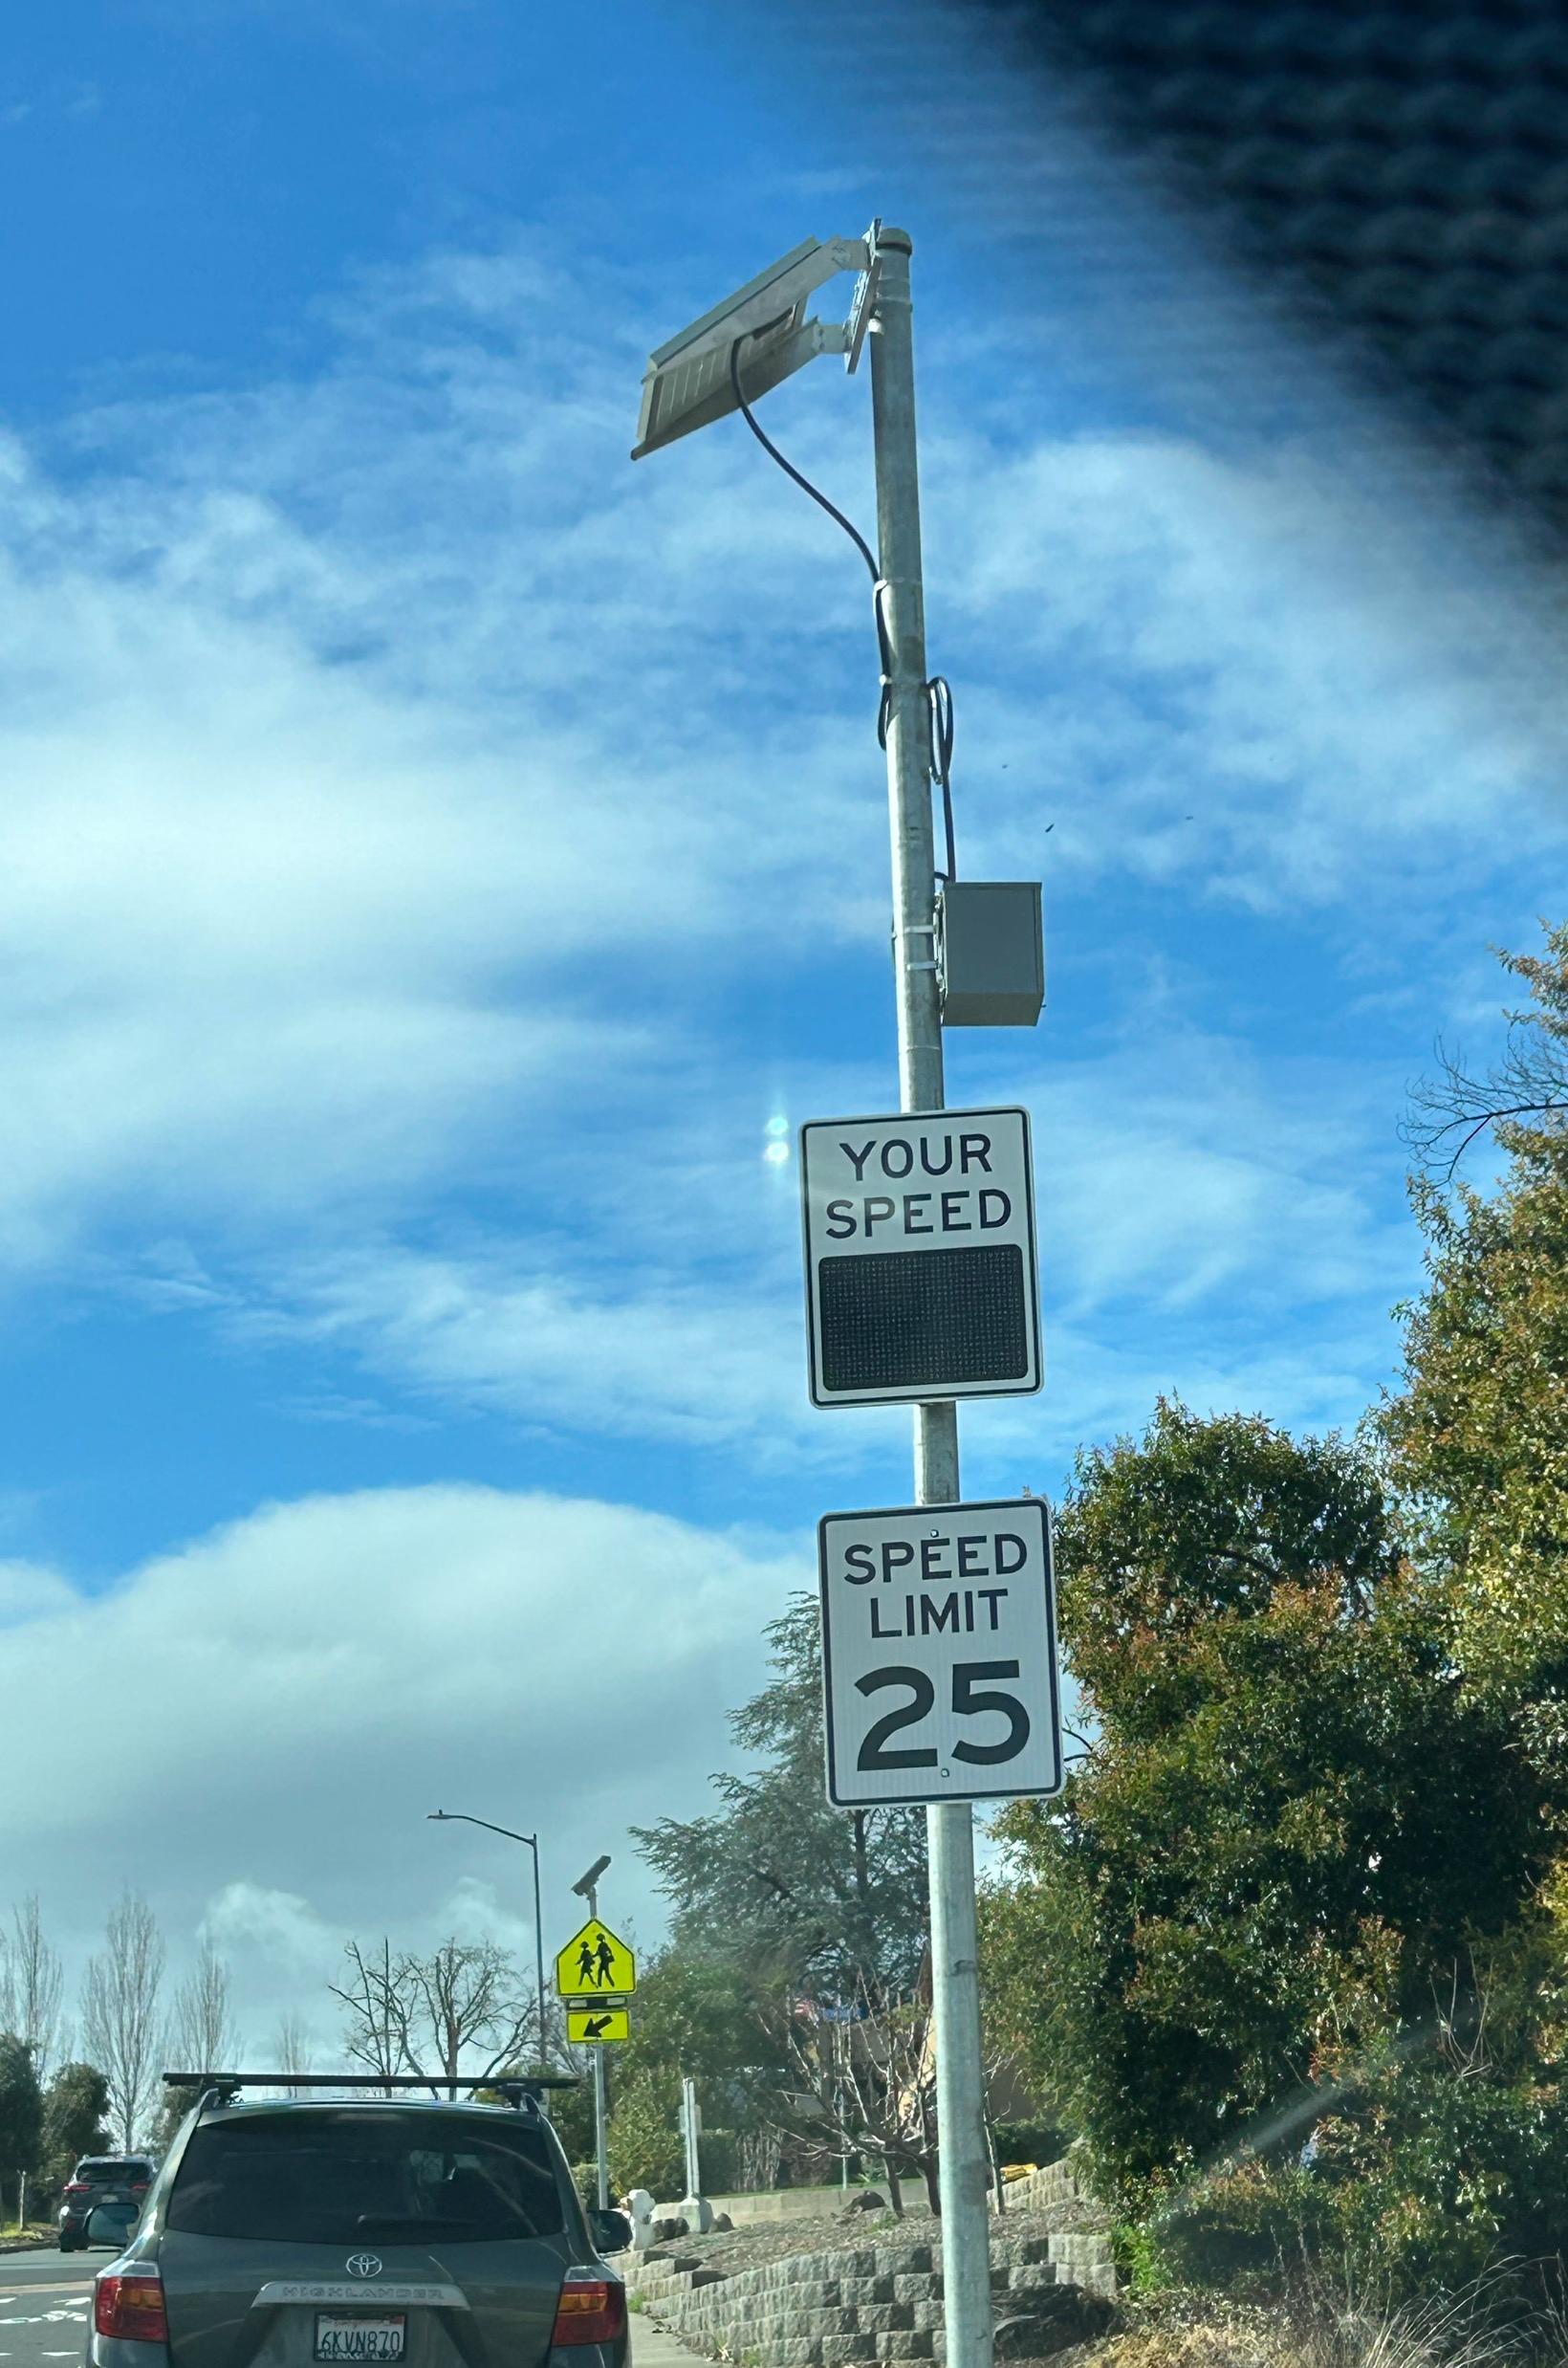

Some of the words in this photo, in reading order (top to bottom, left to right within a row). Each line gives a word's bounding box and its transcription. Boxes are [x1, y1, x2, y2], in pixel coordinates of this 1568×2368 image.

[839, 1133, 992, 1181] YOUR
[826, 1189, 1012, 1239] SPEED
[844, 1533, 1028, 1585] SPEED
[870, 1588, 1009, 1638] LIMIT
[854, 1659, 1031, 1772] 25
[321, 2331, 401, 2353] 6KVN870
